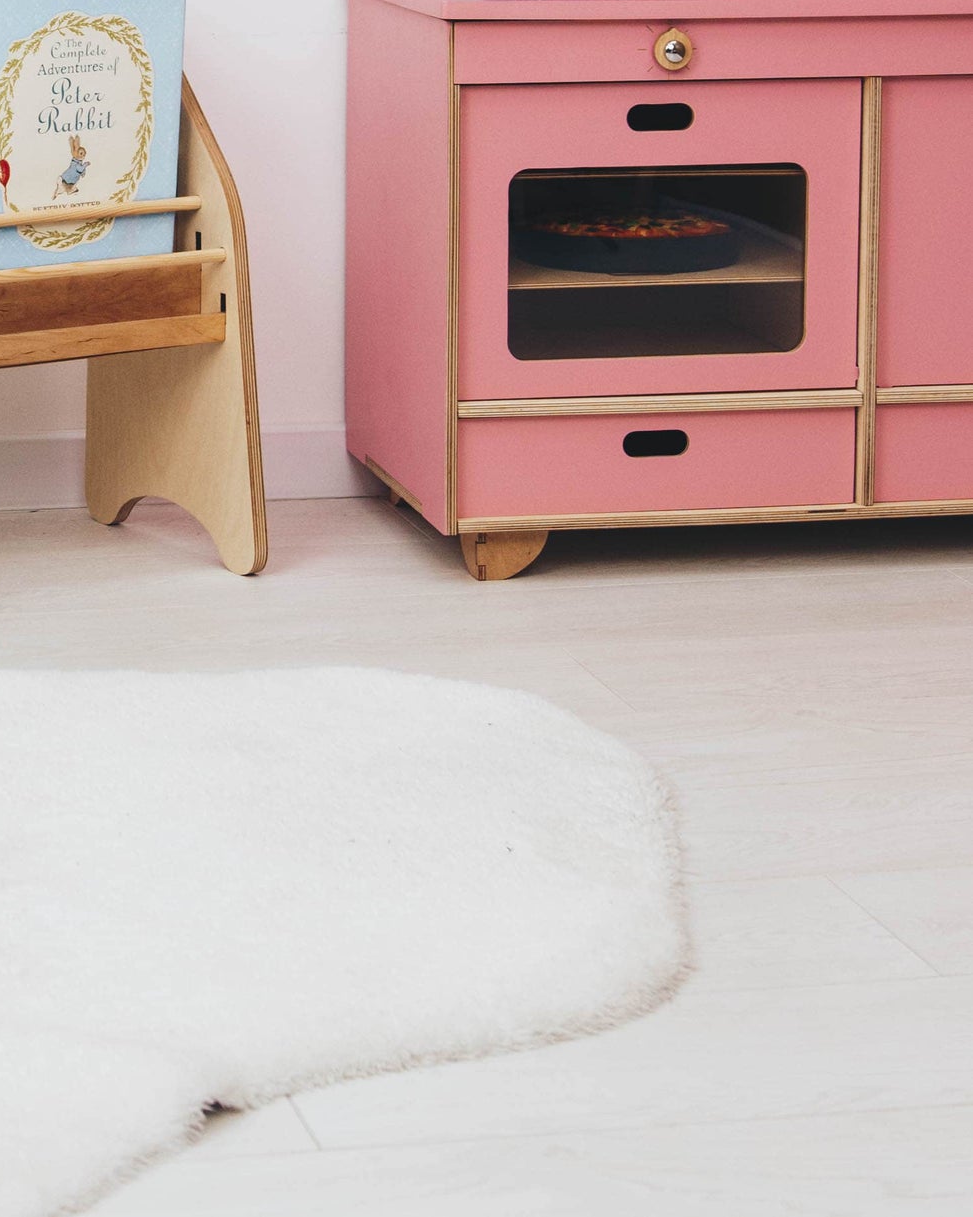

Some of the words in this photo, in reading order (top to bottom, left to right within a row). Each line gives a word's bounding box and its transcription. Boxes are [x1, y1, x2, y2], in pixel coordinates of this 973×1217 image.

[50, 41, 108, 63] Complete
[65, 38, 83, 48] The
[37, 62, 104, 77] Adventures
[106, 56, 120, 76] of
[51, 77, 105, 105] Peter
[37, 105, 115, 135] Rabbit
